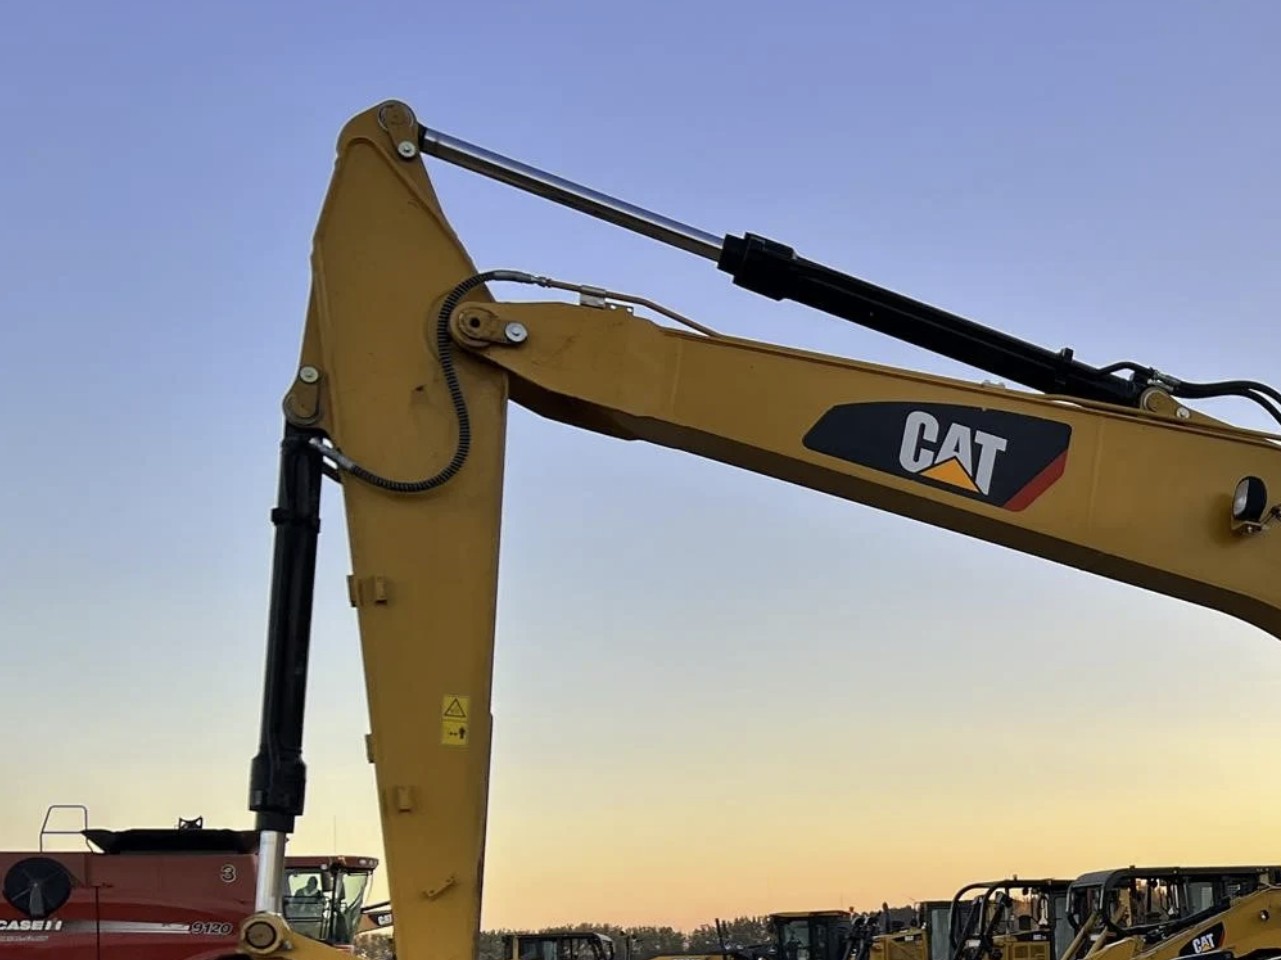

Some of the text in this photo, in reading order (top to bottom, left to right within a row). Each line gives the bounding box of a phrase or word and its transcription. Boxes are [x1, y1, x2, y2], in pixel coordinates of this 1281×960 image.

[900, 410, 1007, 496] CAT
[220, 864, 237, 882] 3
[191, 922, 233, 935] 9120
[1192, 933, 1215, 954] CAT
